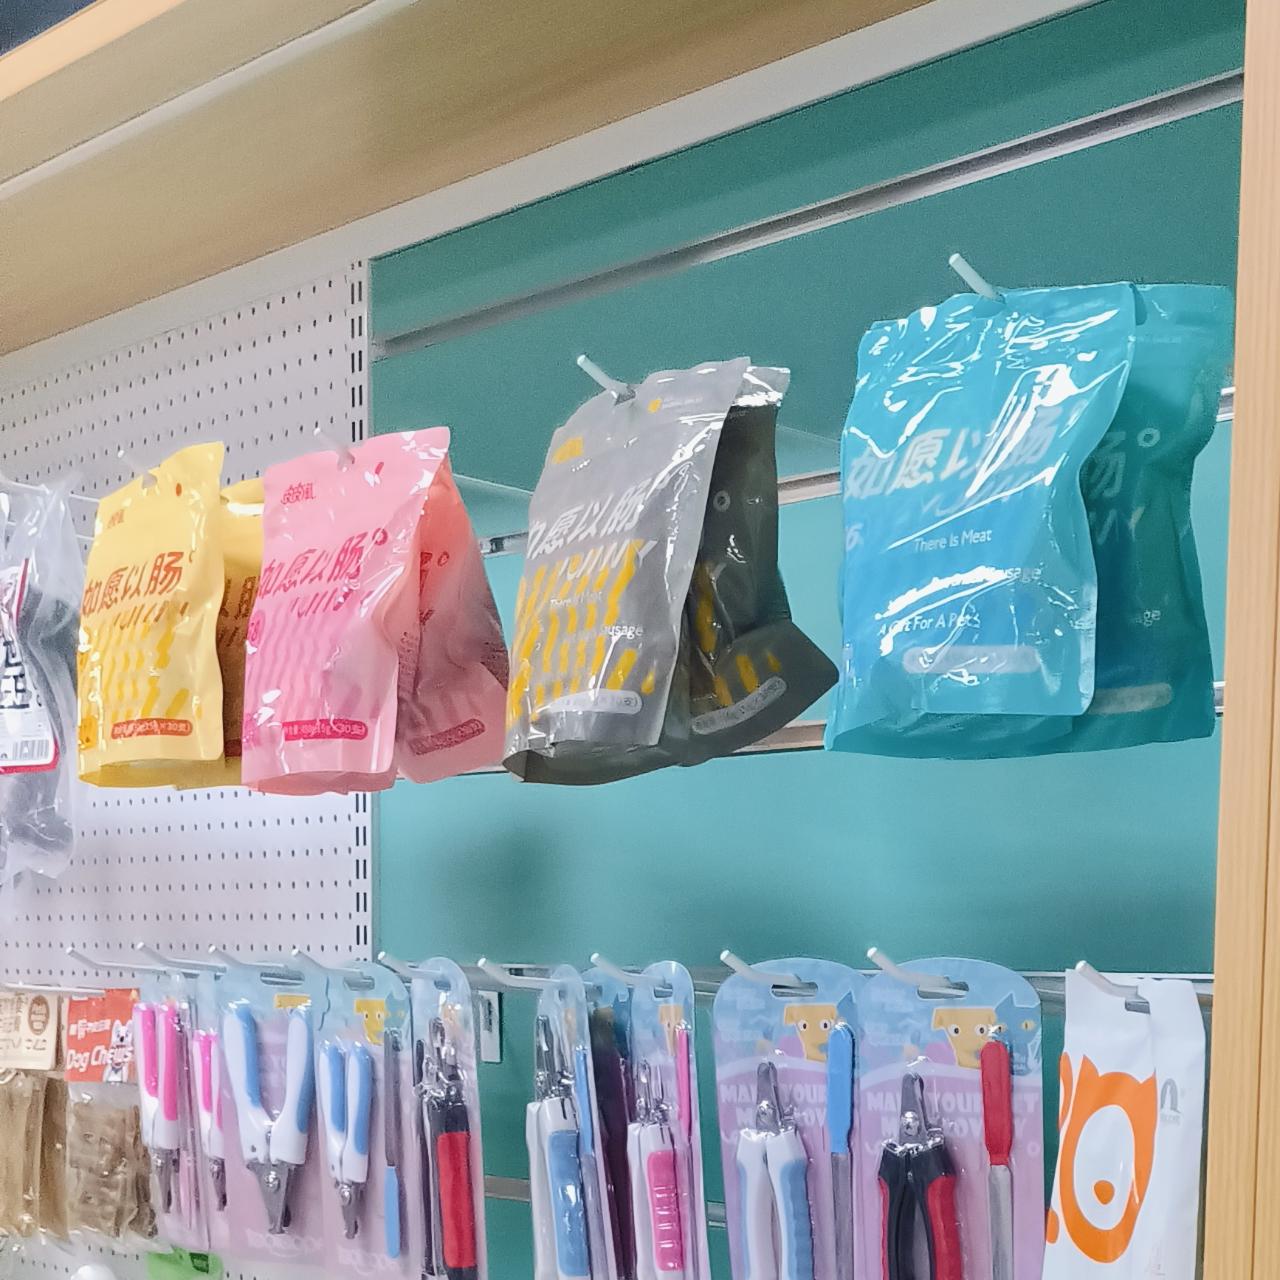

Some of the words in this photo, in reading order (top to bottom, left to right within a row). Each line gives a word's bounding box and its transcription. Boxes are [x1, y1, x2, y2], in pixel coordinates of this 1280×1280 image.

[914, 537, 948, 552] There
[961, 529, 993, 545] Meat
[82, 551, 185, 616] 如愿以肠
[66, 1048, 90, 1072] Dog
